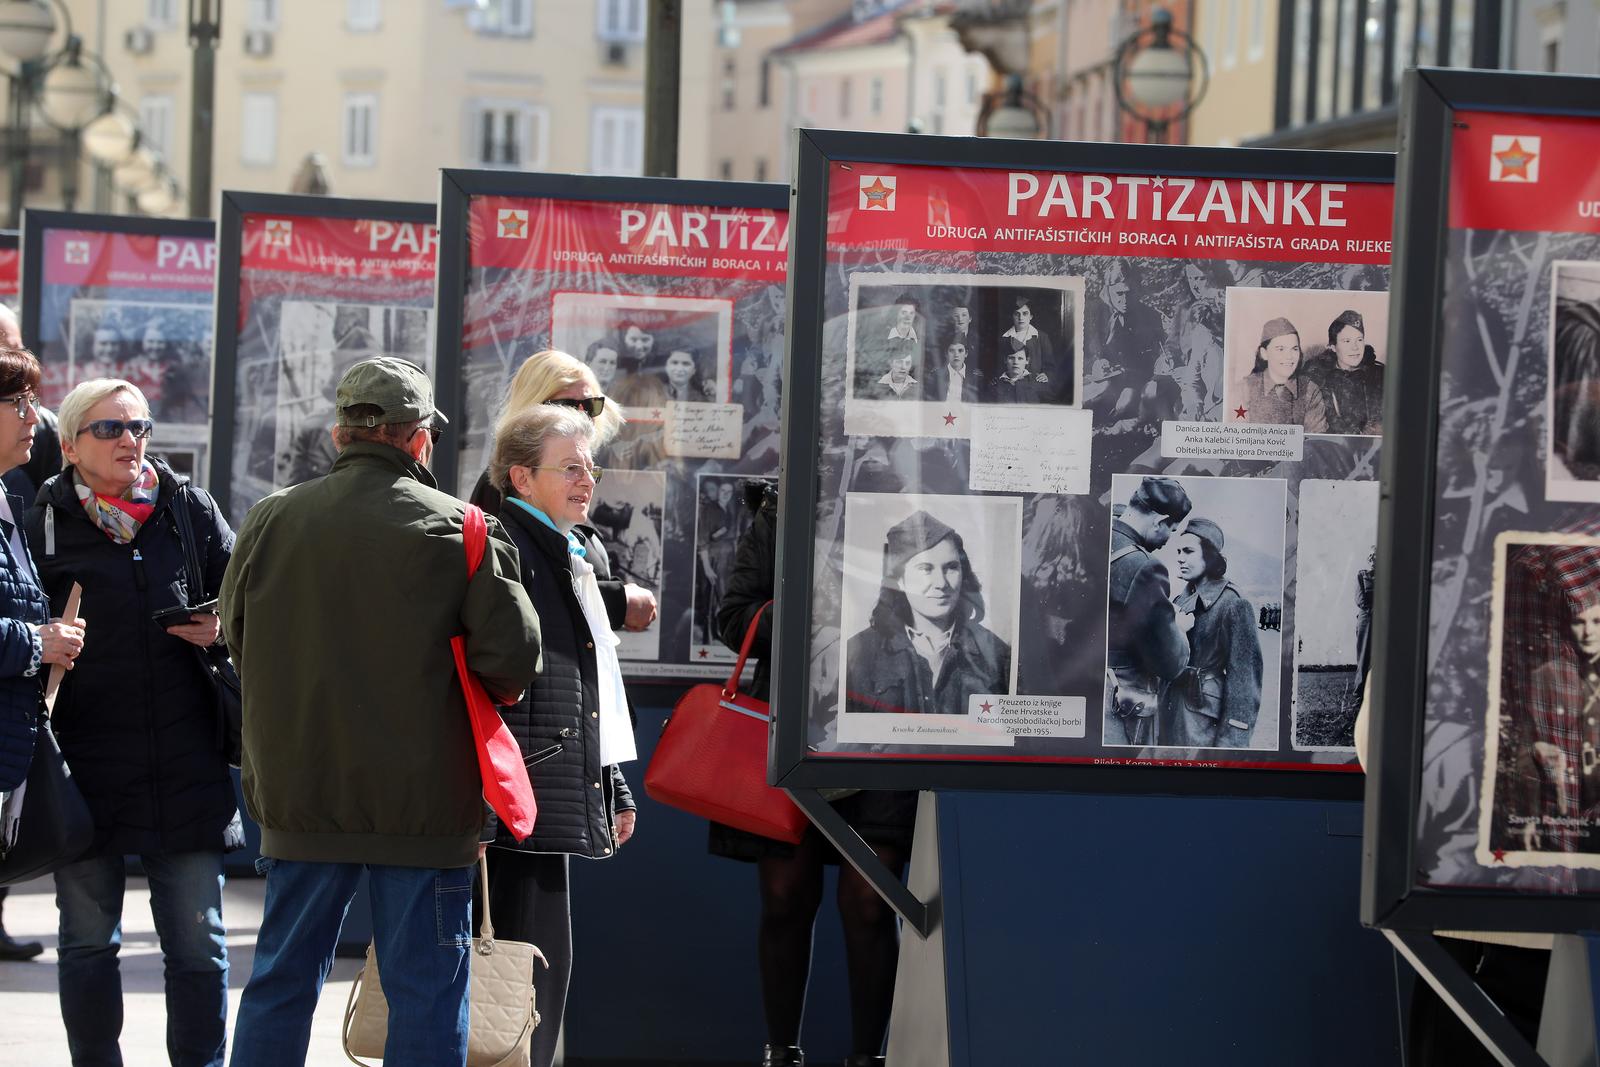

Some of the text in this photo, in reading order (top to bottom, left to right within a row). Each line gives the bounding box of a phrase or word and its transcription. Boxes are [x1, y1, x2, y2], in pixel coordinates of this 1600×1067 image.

[926, 225, 1392, 253] UDRUGA ANTIFAŠISTIČKIH BORACA I ANTIFAŠISTA GRADA RIJEKE
[552, 250, 604, 263] UDRUGA
[609, 252, 707, 268] ANTIFAŠISTIČKIH
[712, 258, 761, 271] BORACA
[1175, 425, 1200, 433] Danica
[1201, 426, 1222, 434] Lozić,
[1223, 426, 1240, 435] Ana,
[1241, 427, 1267, 435] odmilja
[1268, 427, 1288, 435] Anica
[1184, 435, 1203, 443] Anka
[1204, 436, 1230, 444] Kalebić
[1235, 437, 1265, 446] Smiljana
[1175, 446, 1294, 457] Obiteljska arhiva Igora Drvendžije
[998, 698, 1032, 706] Preuzeto
[1040, 699, 1062, 708] knjige
[1000, 707, 1018, 715] Žene
[1020, 708, 1052, 716] Hrvatske
[977, 716, 1082, 726] Narodnooslobodilačkoj borbi
[1006, 727, 1052, 736] Zagreb 1955.
